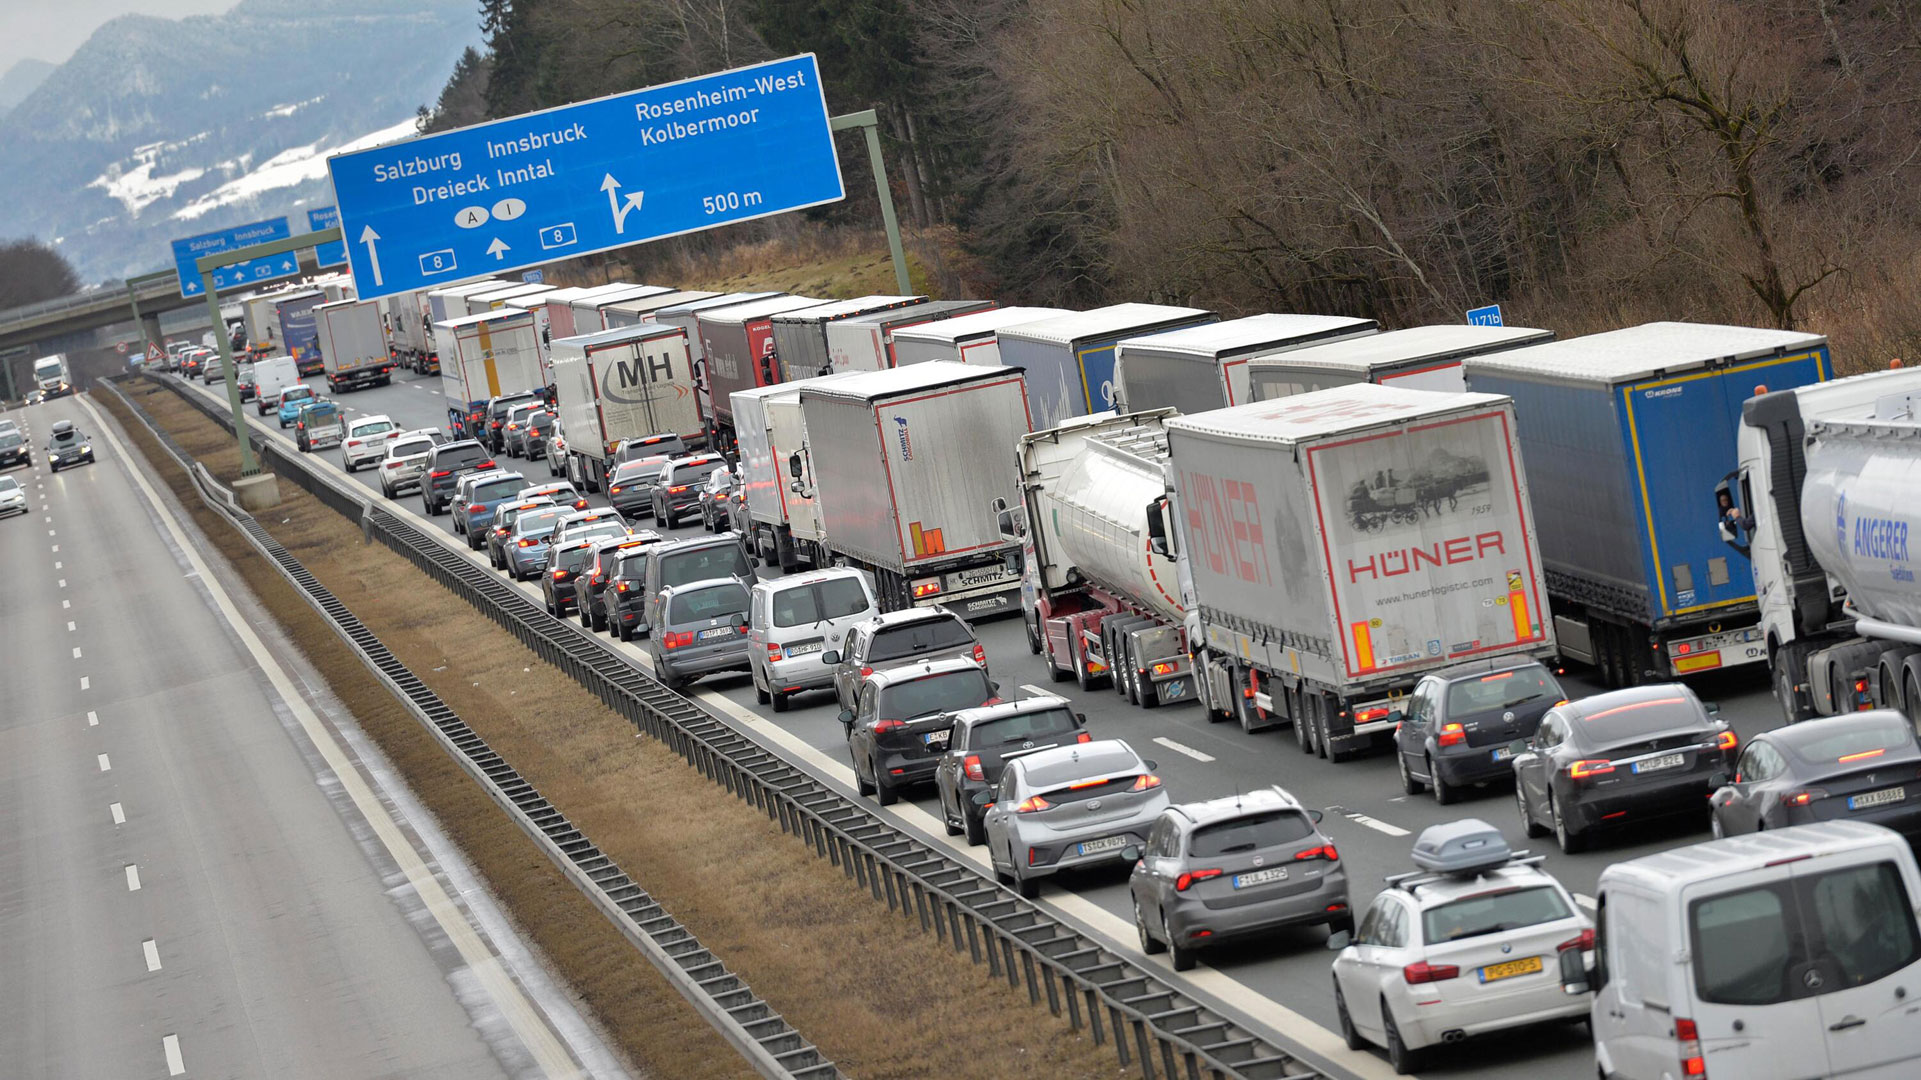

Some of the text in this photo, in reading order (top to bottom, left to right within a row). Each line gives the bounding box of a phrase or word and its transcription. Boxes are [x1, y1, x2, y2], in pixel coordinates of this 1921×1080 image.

[635, 70, 806, 121] Rosenheim-West
[640, 108, 760, 146] Kolbermoor
[374, 123, 588, 182] Salzburg Innsbruck
[412, 159, 555, 204] Dreieck Inntal
[467, 211, 478, 224] A
[703, 191, 763, 215] 500 m
[189, 226, 276, 251] Salzburg Innsbruck
[553, 230, 563, 242] 8
[433, 256, 443, 268] 8
[616, 352, 673, 389] MH
[898, 428, 909, 462] SCHMITZ
[1470, 503, 1492, 516] 1959
[1180, 470, 1273, 588] HÜNER
[1854, 516, 1909, 562] ANGERER
[1347, 530, 1507, 584] HÜNER
[961, 572, 1004, 587] SCHMITZ
[1375, 576, 1494, 607] www.hunerlogistic.com
